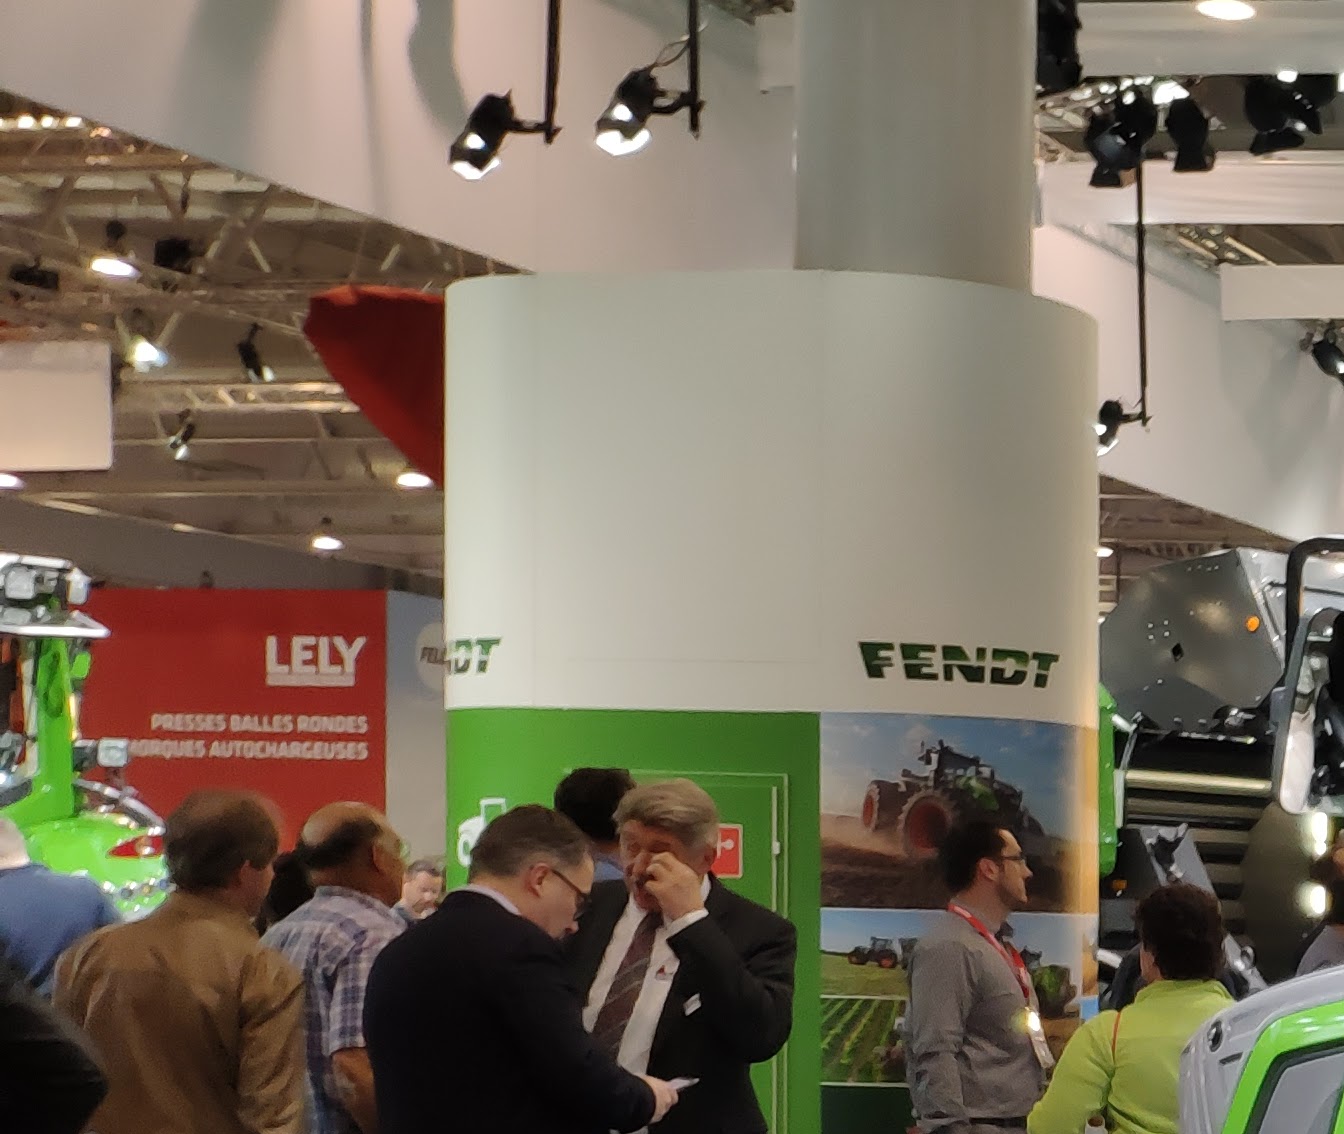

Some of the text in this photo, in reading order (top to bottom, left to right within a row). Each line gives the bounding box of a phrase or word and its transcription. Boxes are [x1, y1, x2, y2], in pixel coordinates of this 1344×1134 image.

[265, 635, 368, 677] LELY
[444, 636, 501, 676] DT
[858, 640, 1061, 689] FENDT
[151, 713, 227, 732] PRESSES
[297, 715, 369, 734] RONDES
